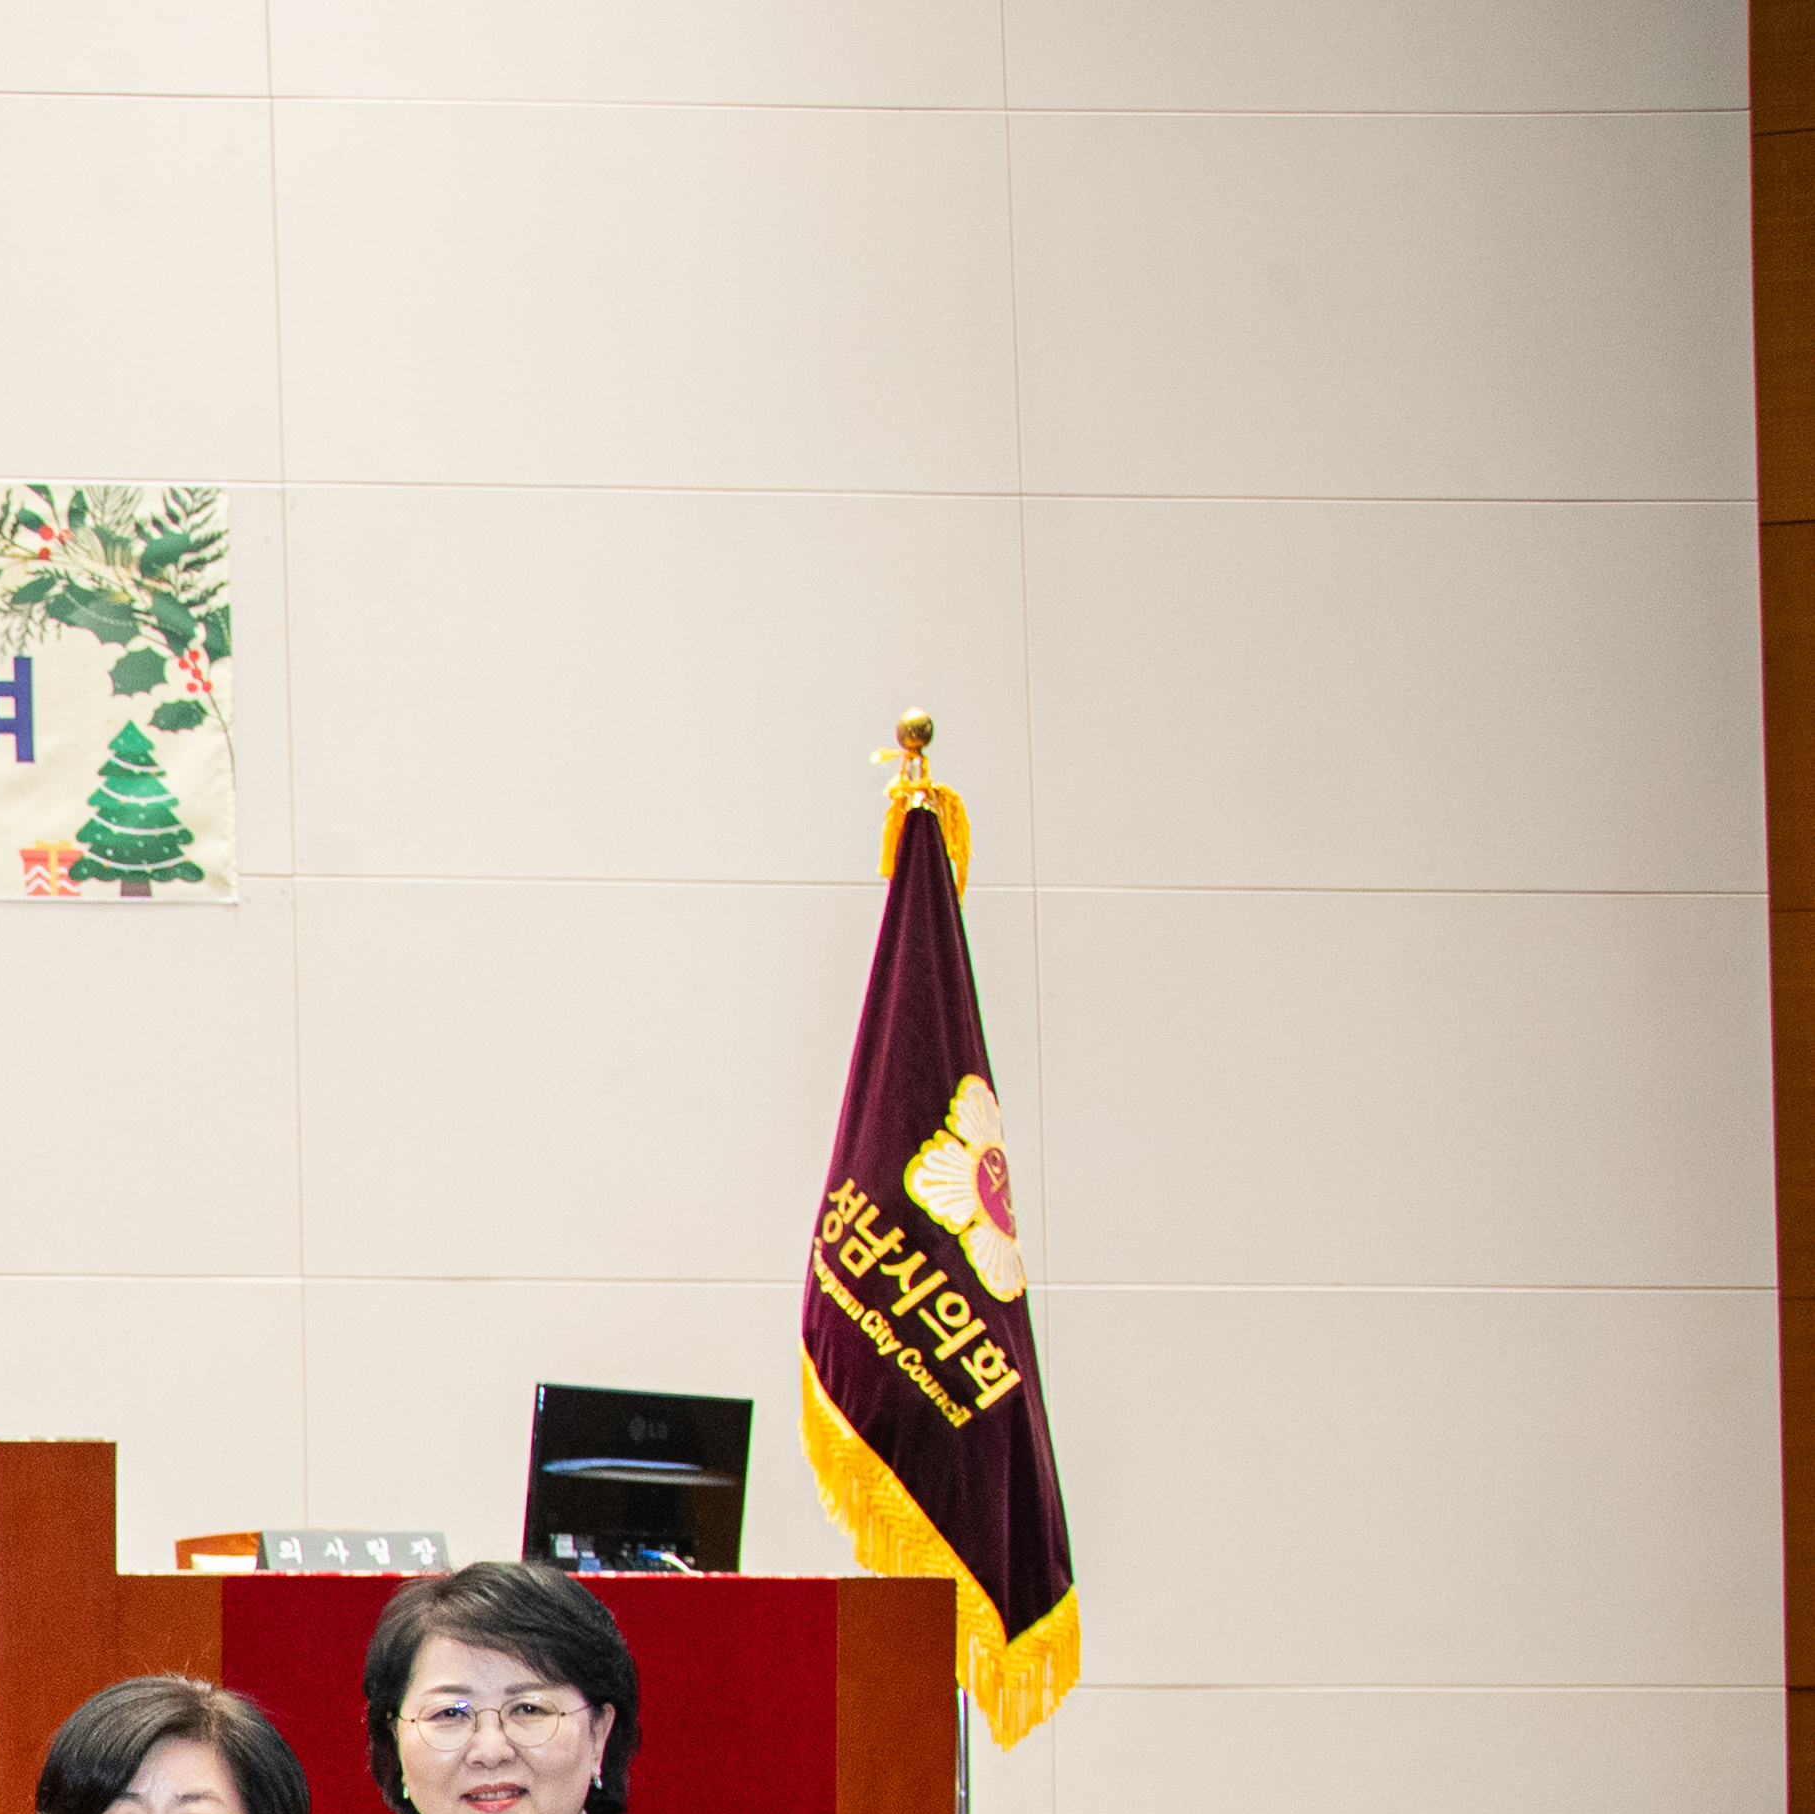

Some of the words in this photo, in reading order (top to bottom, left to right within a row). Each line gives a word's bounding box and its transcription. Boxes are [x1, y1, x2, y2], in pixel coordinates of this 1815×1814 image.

[822, 1177, 1021, 1410] 성남시의회
[859, 1309, 903, 1356] City
[896, 1347, 973, 1429] Council
